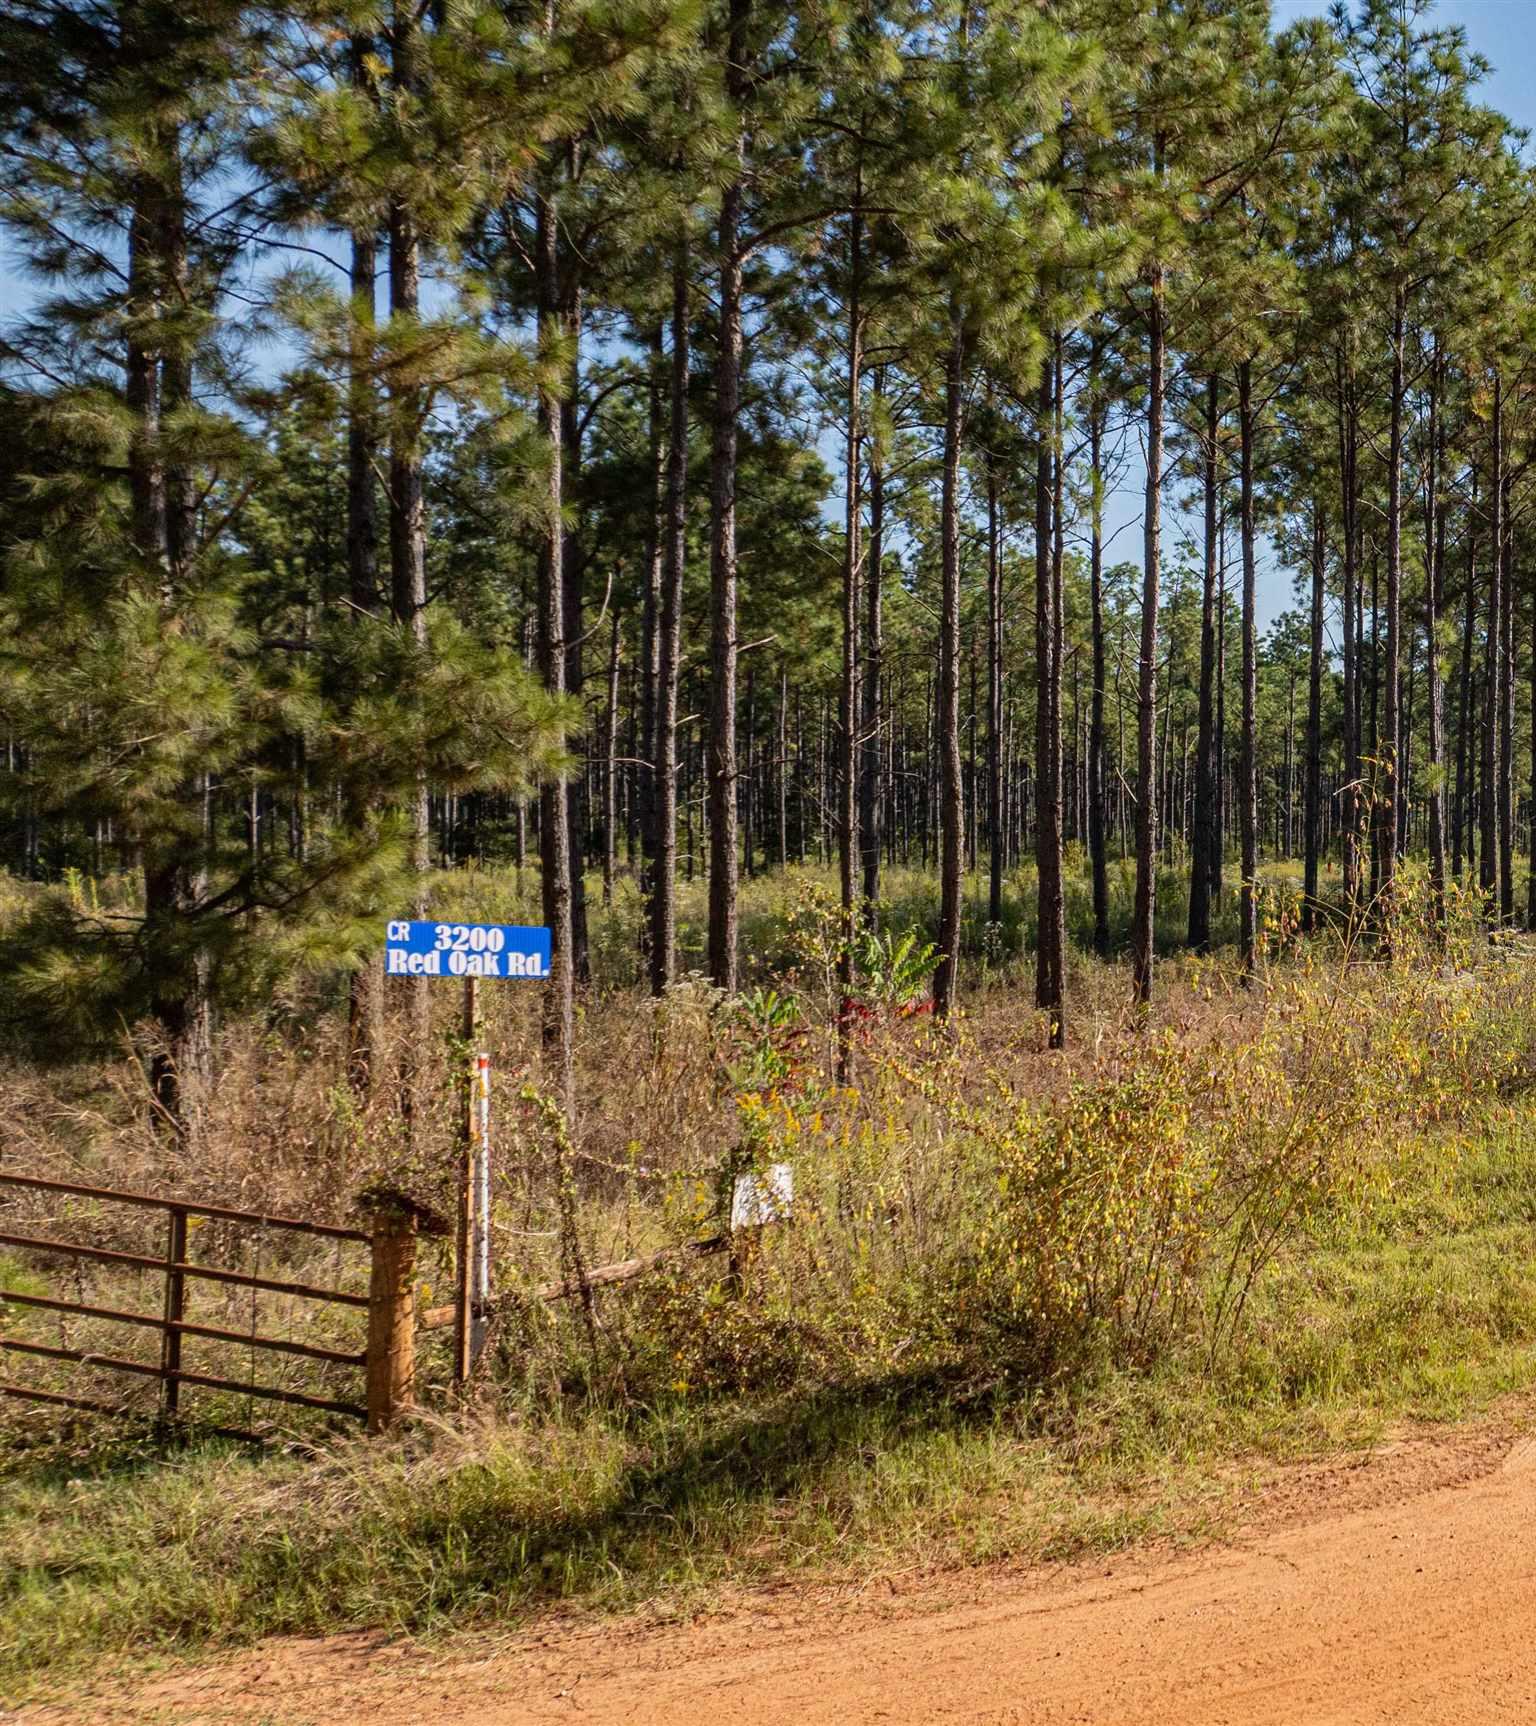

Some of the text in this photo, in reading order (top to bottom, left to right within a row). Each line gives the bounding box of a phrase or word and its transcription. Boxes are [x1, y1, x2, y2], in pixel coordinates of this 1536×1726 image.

[387, 920, 505, 952] CR 3200
[387, 948, 550, 976] Red Oak Rd.
